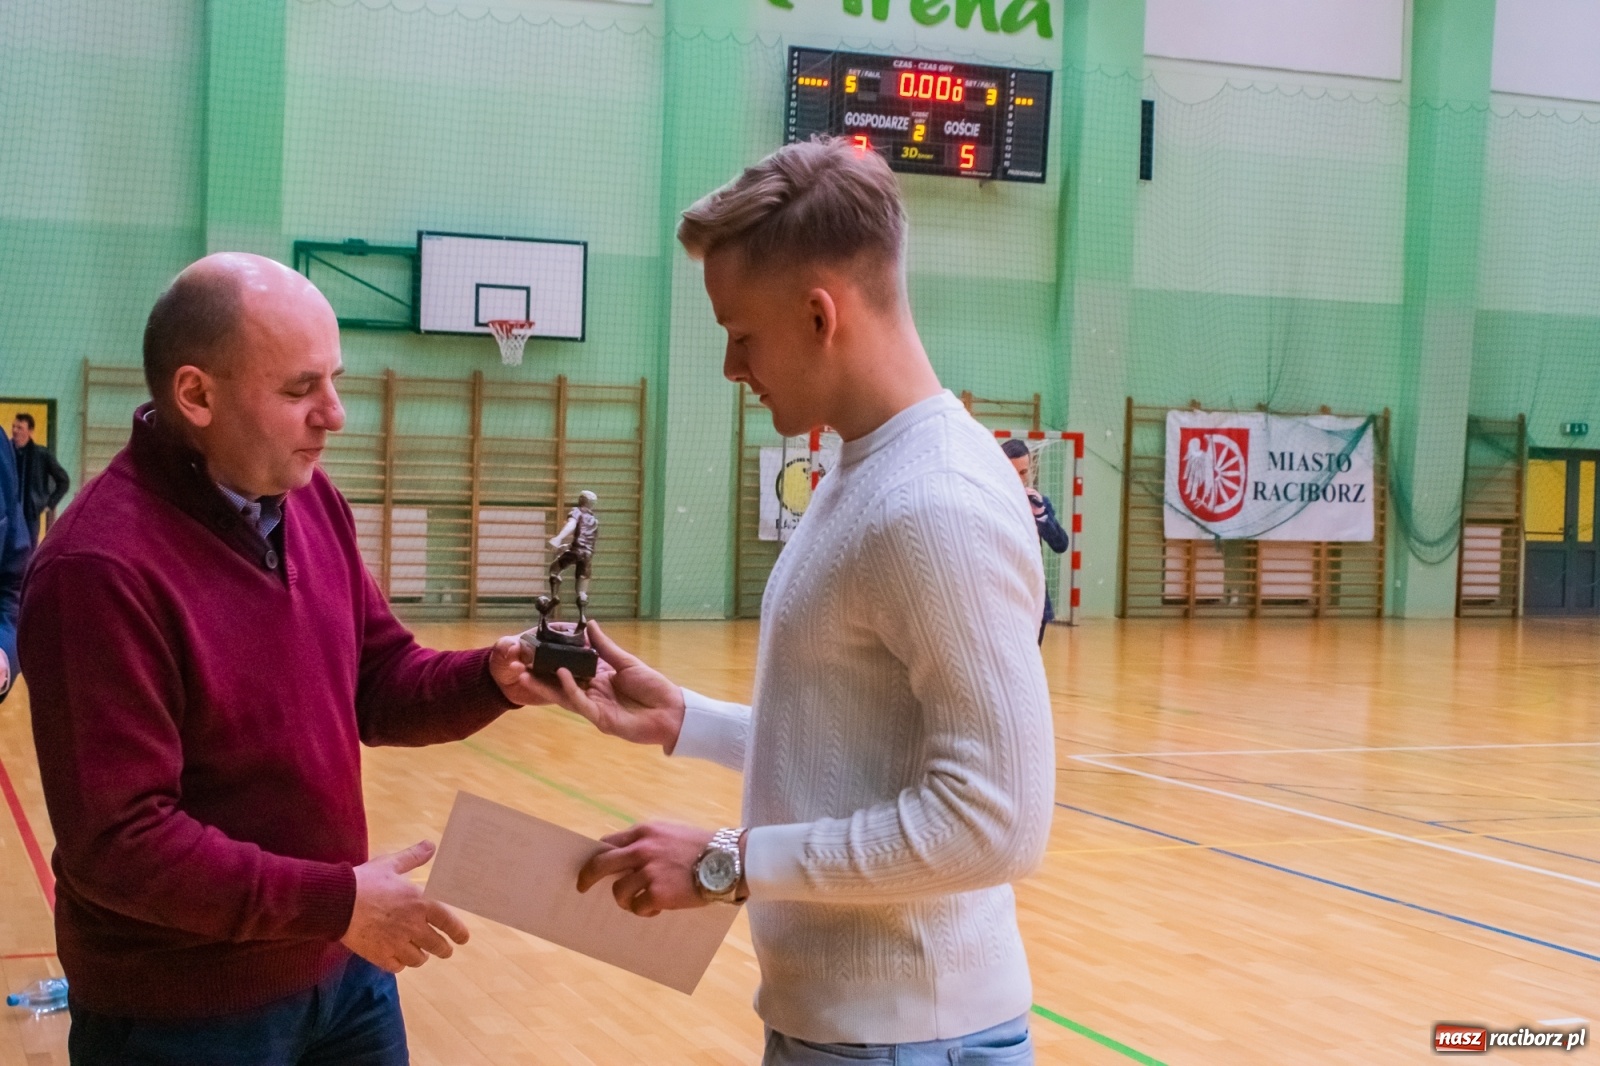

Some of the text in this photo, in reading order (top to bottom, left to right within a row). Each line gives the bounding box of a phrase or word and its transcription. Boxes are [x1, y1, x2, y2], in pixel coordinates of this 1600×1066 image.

[845, 76, 857, 93] 5
[986, 88, 998, 106] 3
[844, 112, 910, 131] GOSPODARZE
[944, 118, 981, 137] GOŚCIE
[913, 124, 926, 142] 2
[960, 144, 975, 168] 5
[1267, 451, 1352, 473] MIASTO
[1252, 481, 1366, 503] RACIBORZ
